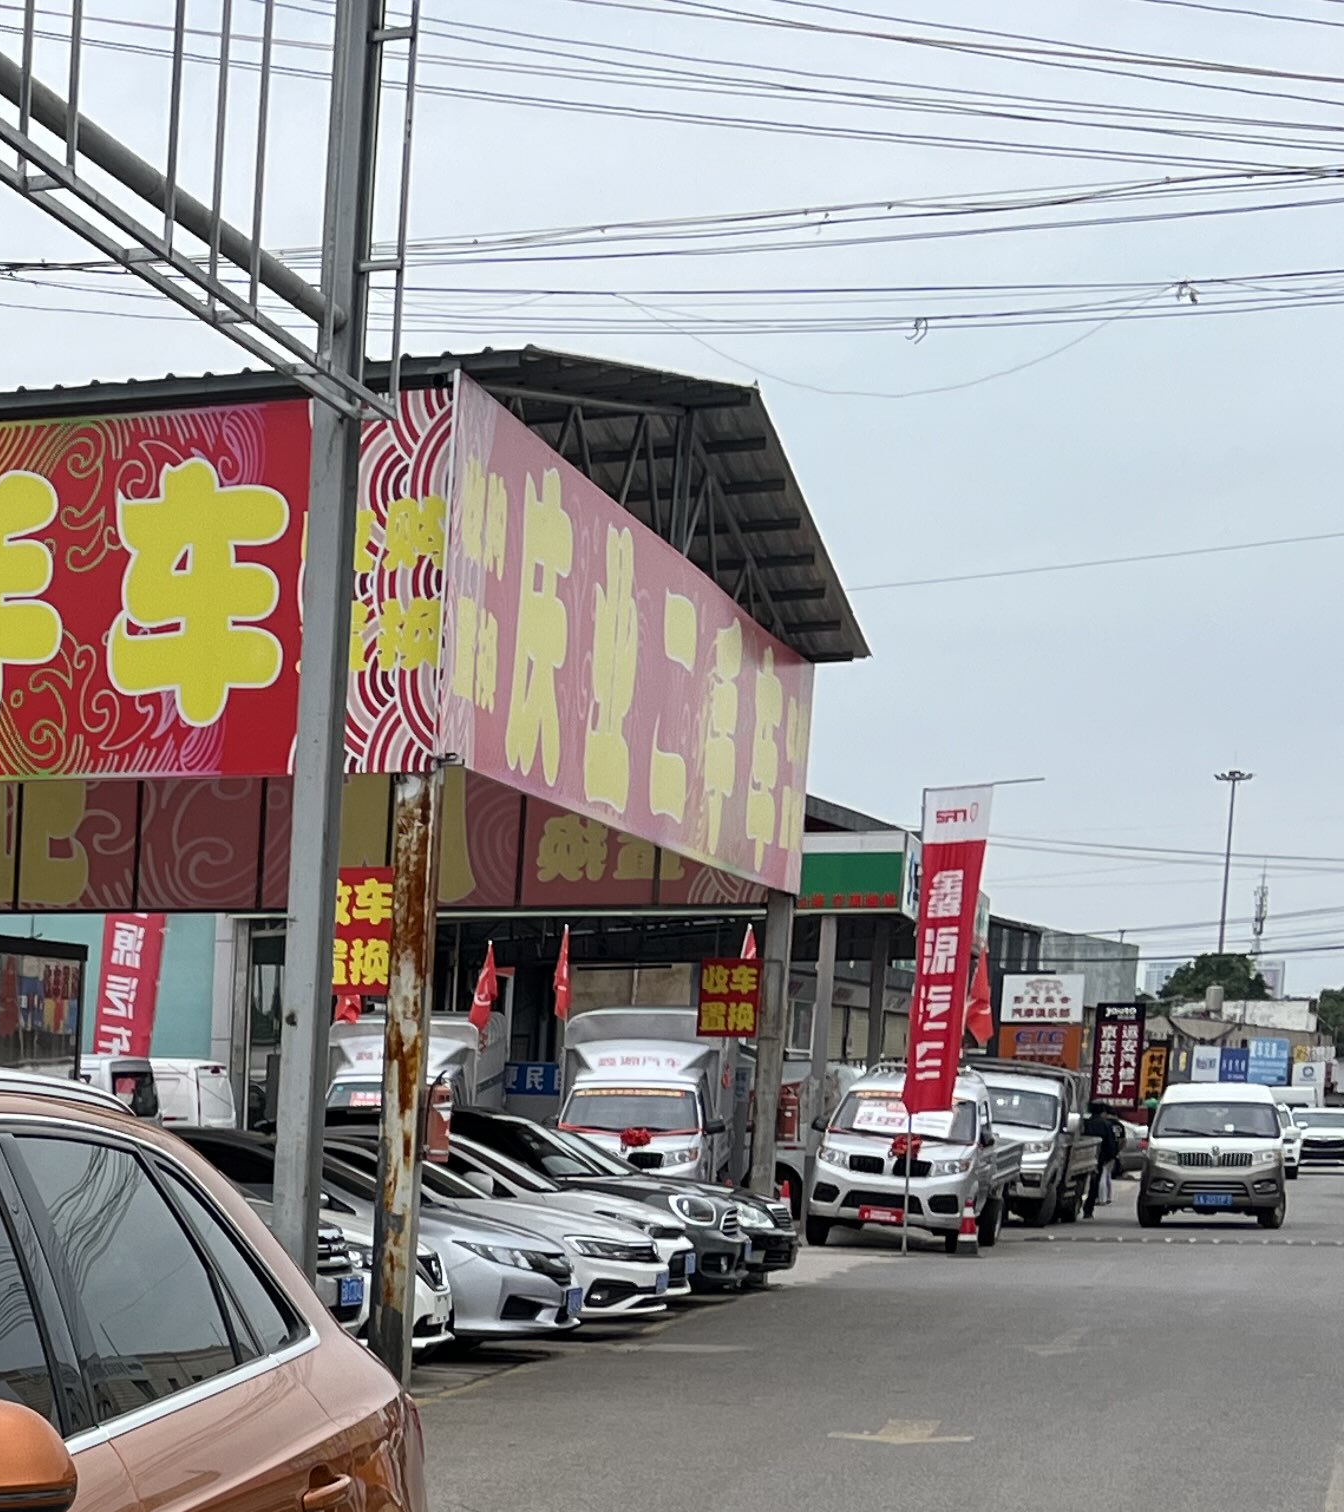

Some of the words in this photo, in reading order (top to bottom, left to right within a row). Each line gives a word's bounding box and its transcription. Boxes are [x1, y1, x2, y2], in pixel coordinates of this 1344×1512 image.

[505, 467, 783, 873] 庆业二手车
[701, 964, 758, 995] 收车
